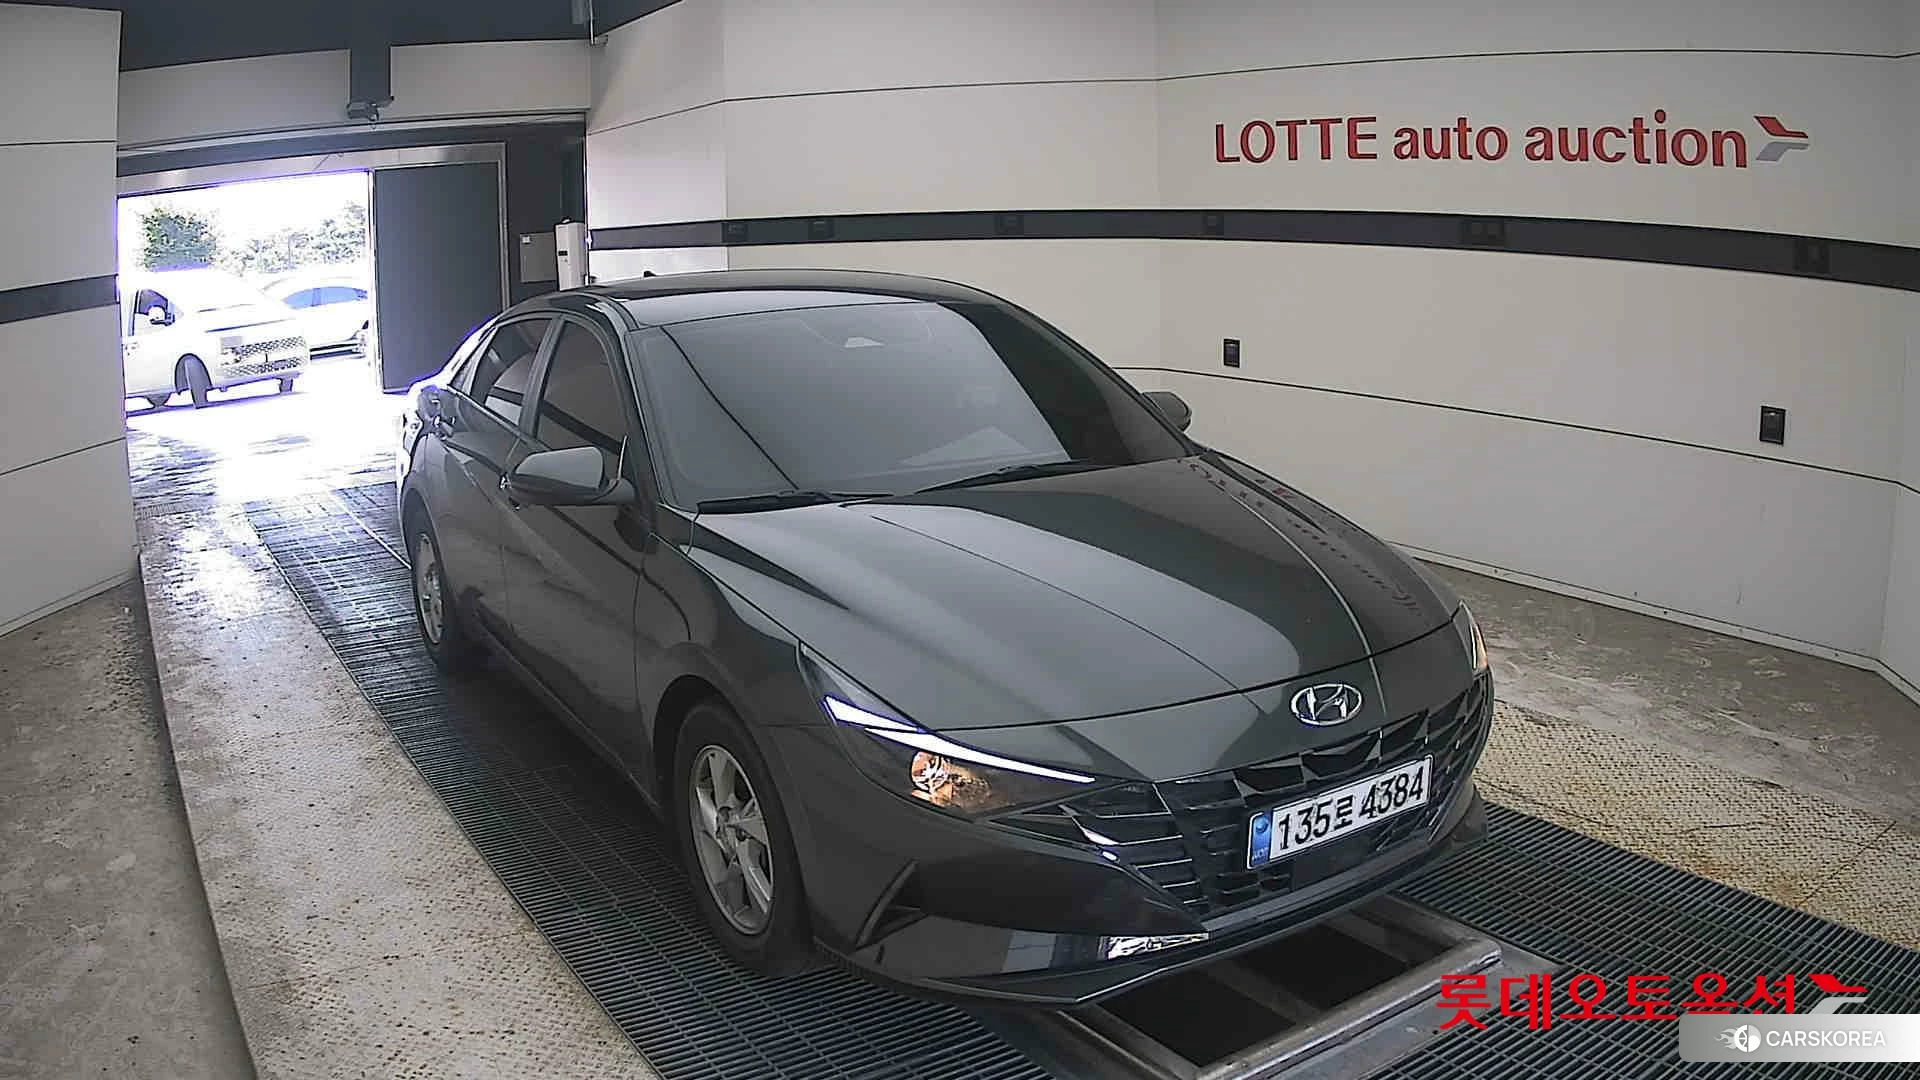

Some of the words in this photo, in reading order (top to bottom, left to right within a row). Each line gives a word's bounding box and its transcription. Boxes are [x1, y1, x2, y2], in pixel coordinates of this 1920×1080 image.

[1215, 116, 1377, 164] LOTTE
[1393, 117, 1508, 161] auto
[1525, 109, 1748, 168] auction
[1279, 794, 1353, 850] 135로
[1359, 766, 1424, 819] 4384
